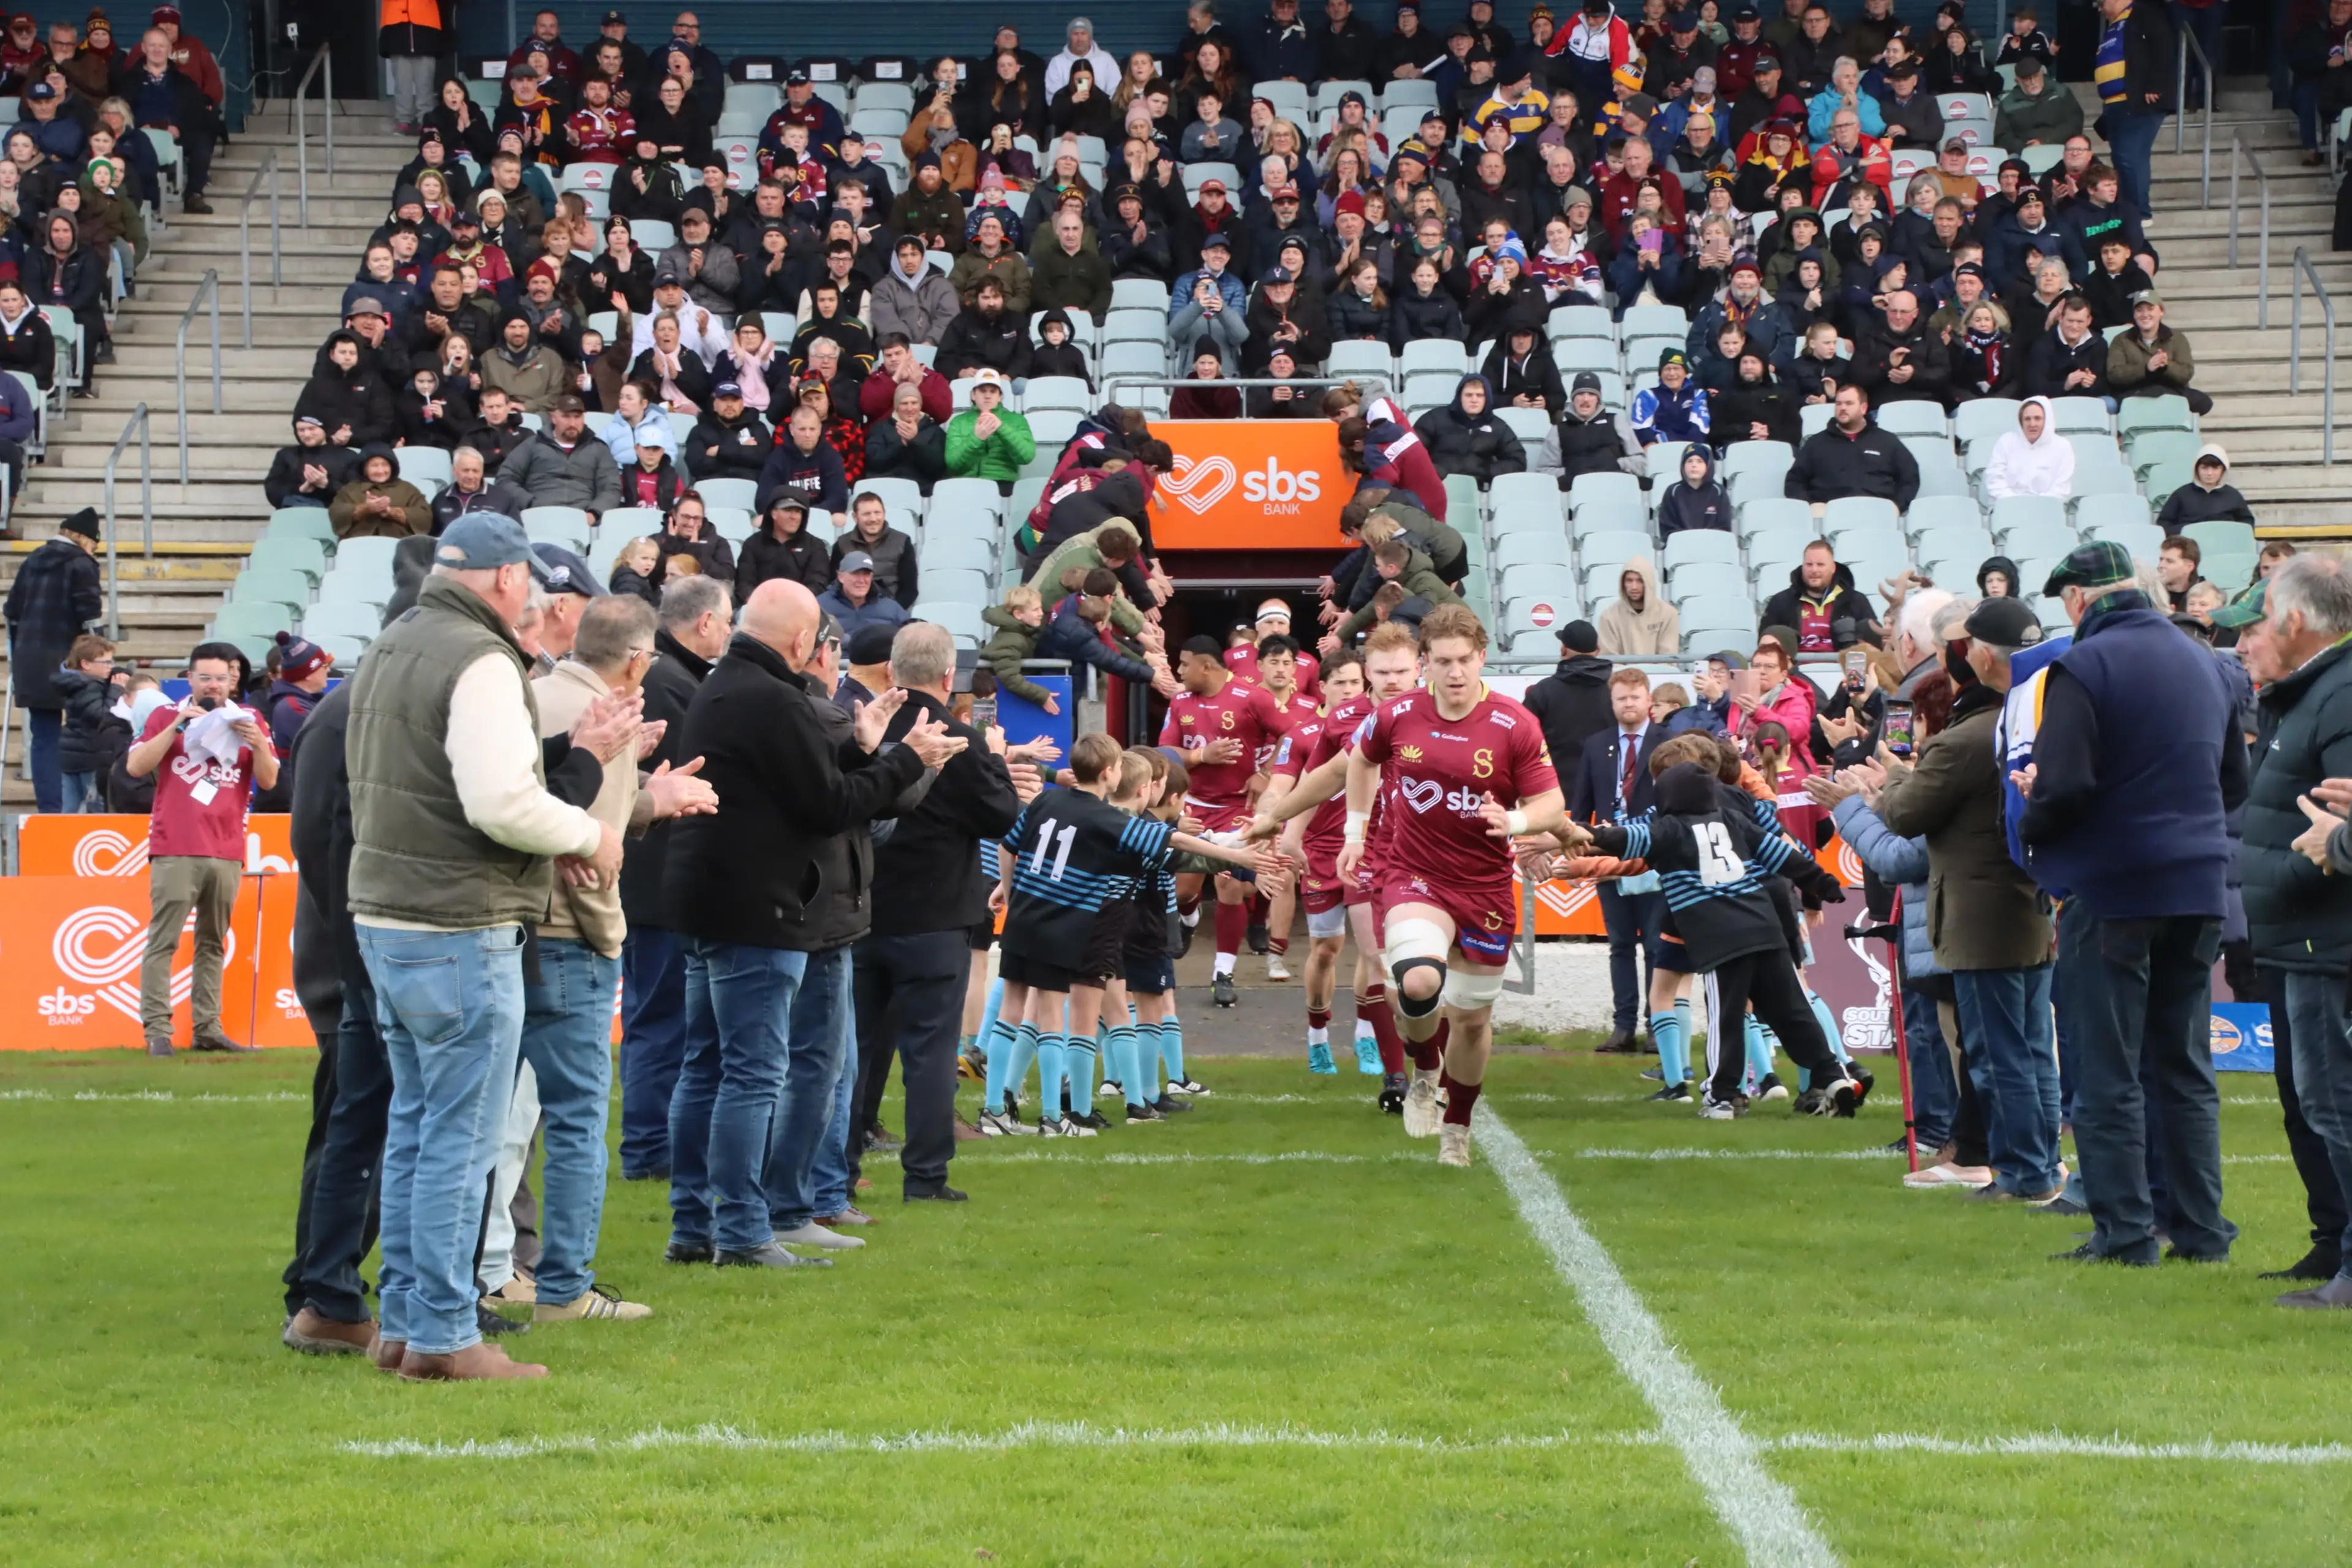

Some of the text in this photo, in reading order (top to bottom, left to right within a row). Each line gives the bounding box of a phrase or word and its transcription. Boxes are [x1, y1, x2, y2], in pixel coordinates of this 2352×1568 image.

[475, 256, 486, 268] S
[1243, 456, 1321, 502] sbs
[1264, 503, 1300, 515] BANK
[1221, 710, 1235, 730] S
[1472, 748, 1493, 778] S
[1028, 818, 1076, 882] 11
[1692, 821, 1746, 887] 13
[1466, 937, 1505, 951] FARMING
[38, 986, 95, 1015] sbs
[48, 1015, 85, 1026] BANK
